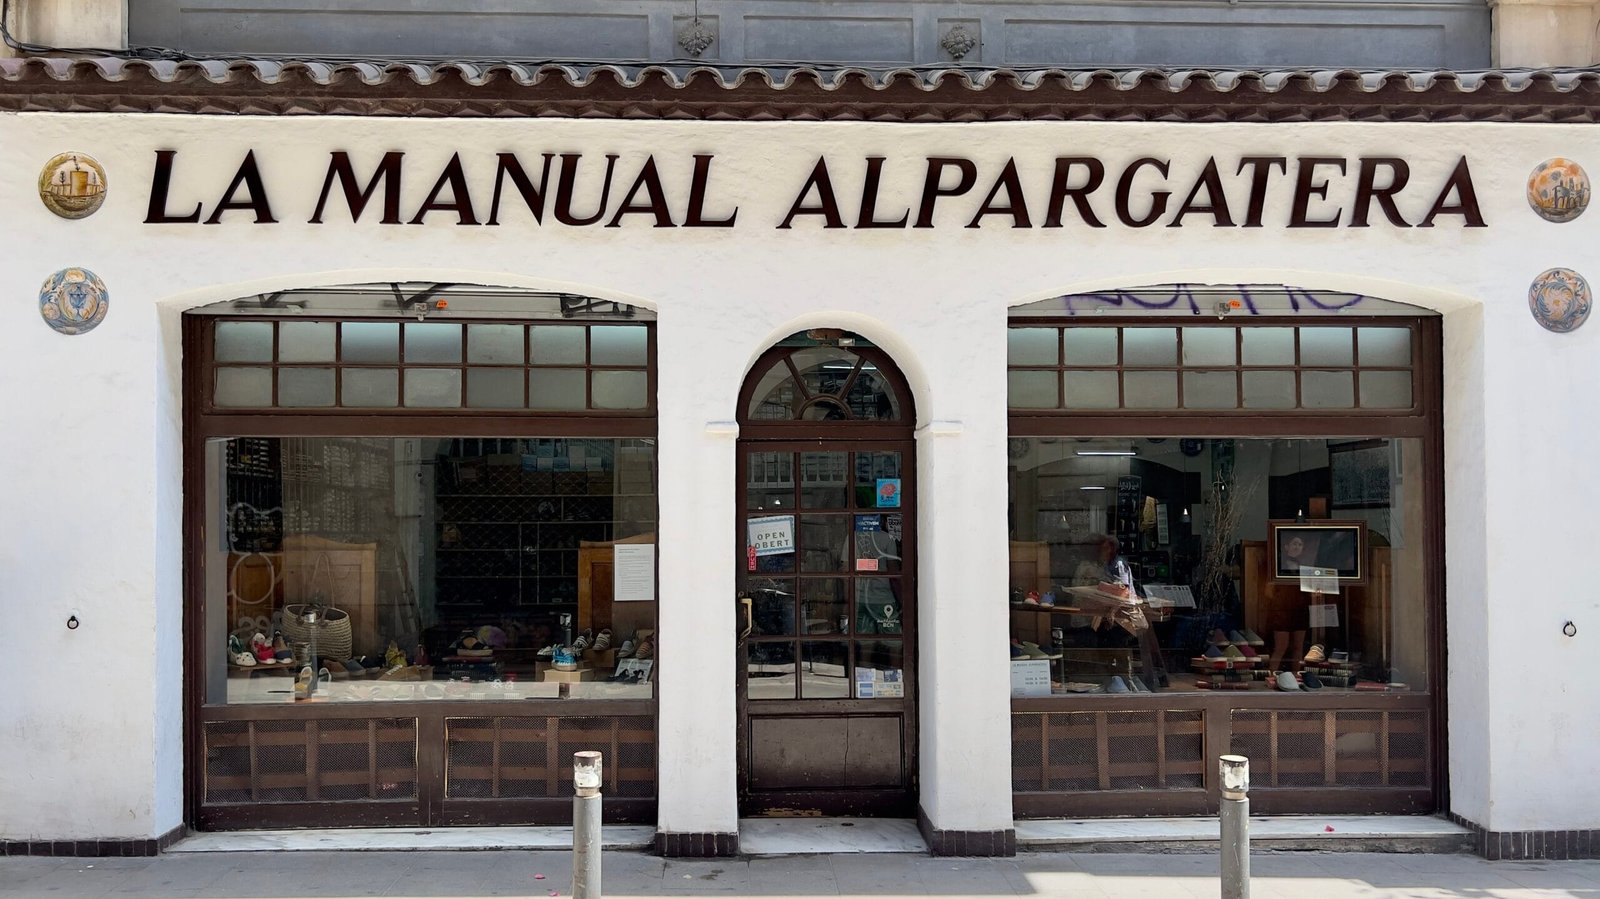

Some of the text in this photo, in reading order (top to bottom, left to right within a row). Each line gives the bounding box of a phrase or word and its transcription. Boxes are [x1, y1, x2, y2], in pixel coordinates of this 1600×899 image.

[143, 149, 1488, 229] LA MANUAL ALPARGATERA
[757, 531, 785, 540] OPEN
[755, 539, 790, 549] OBERT
